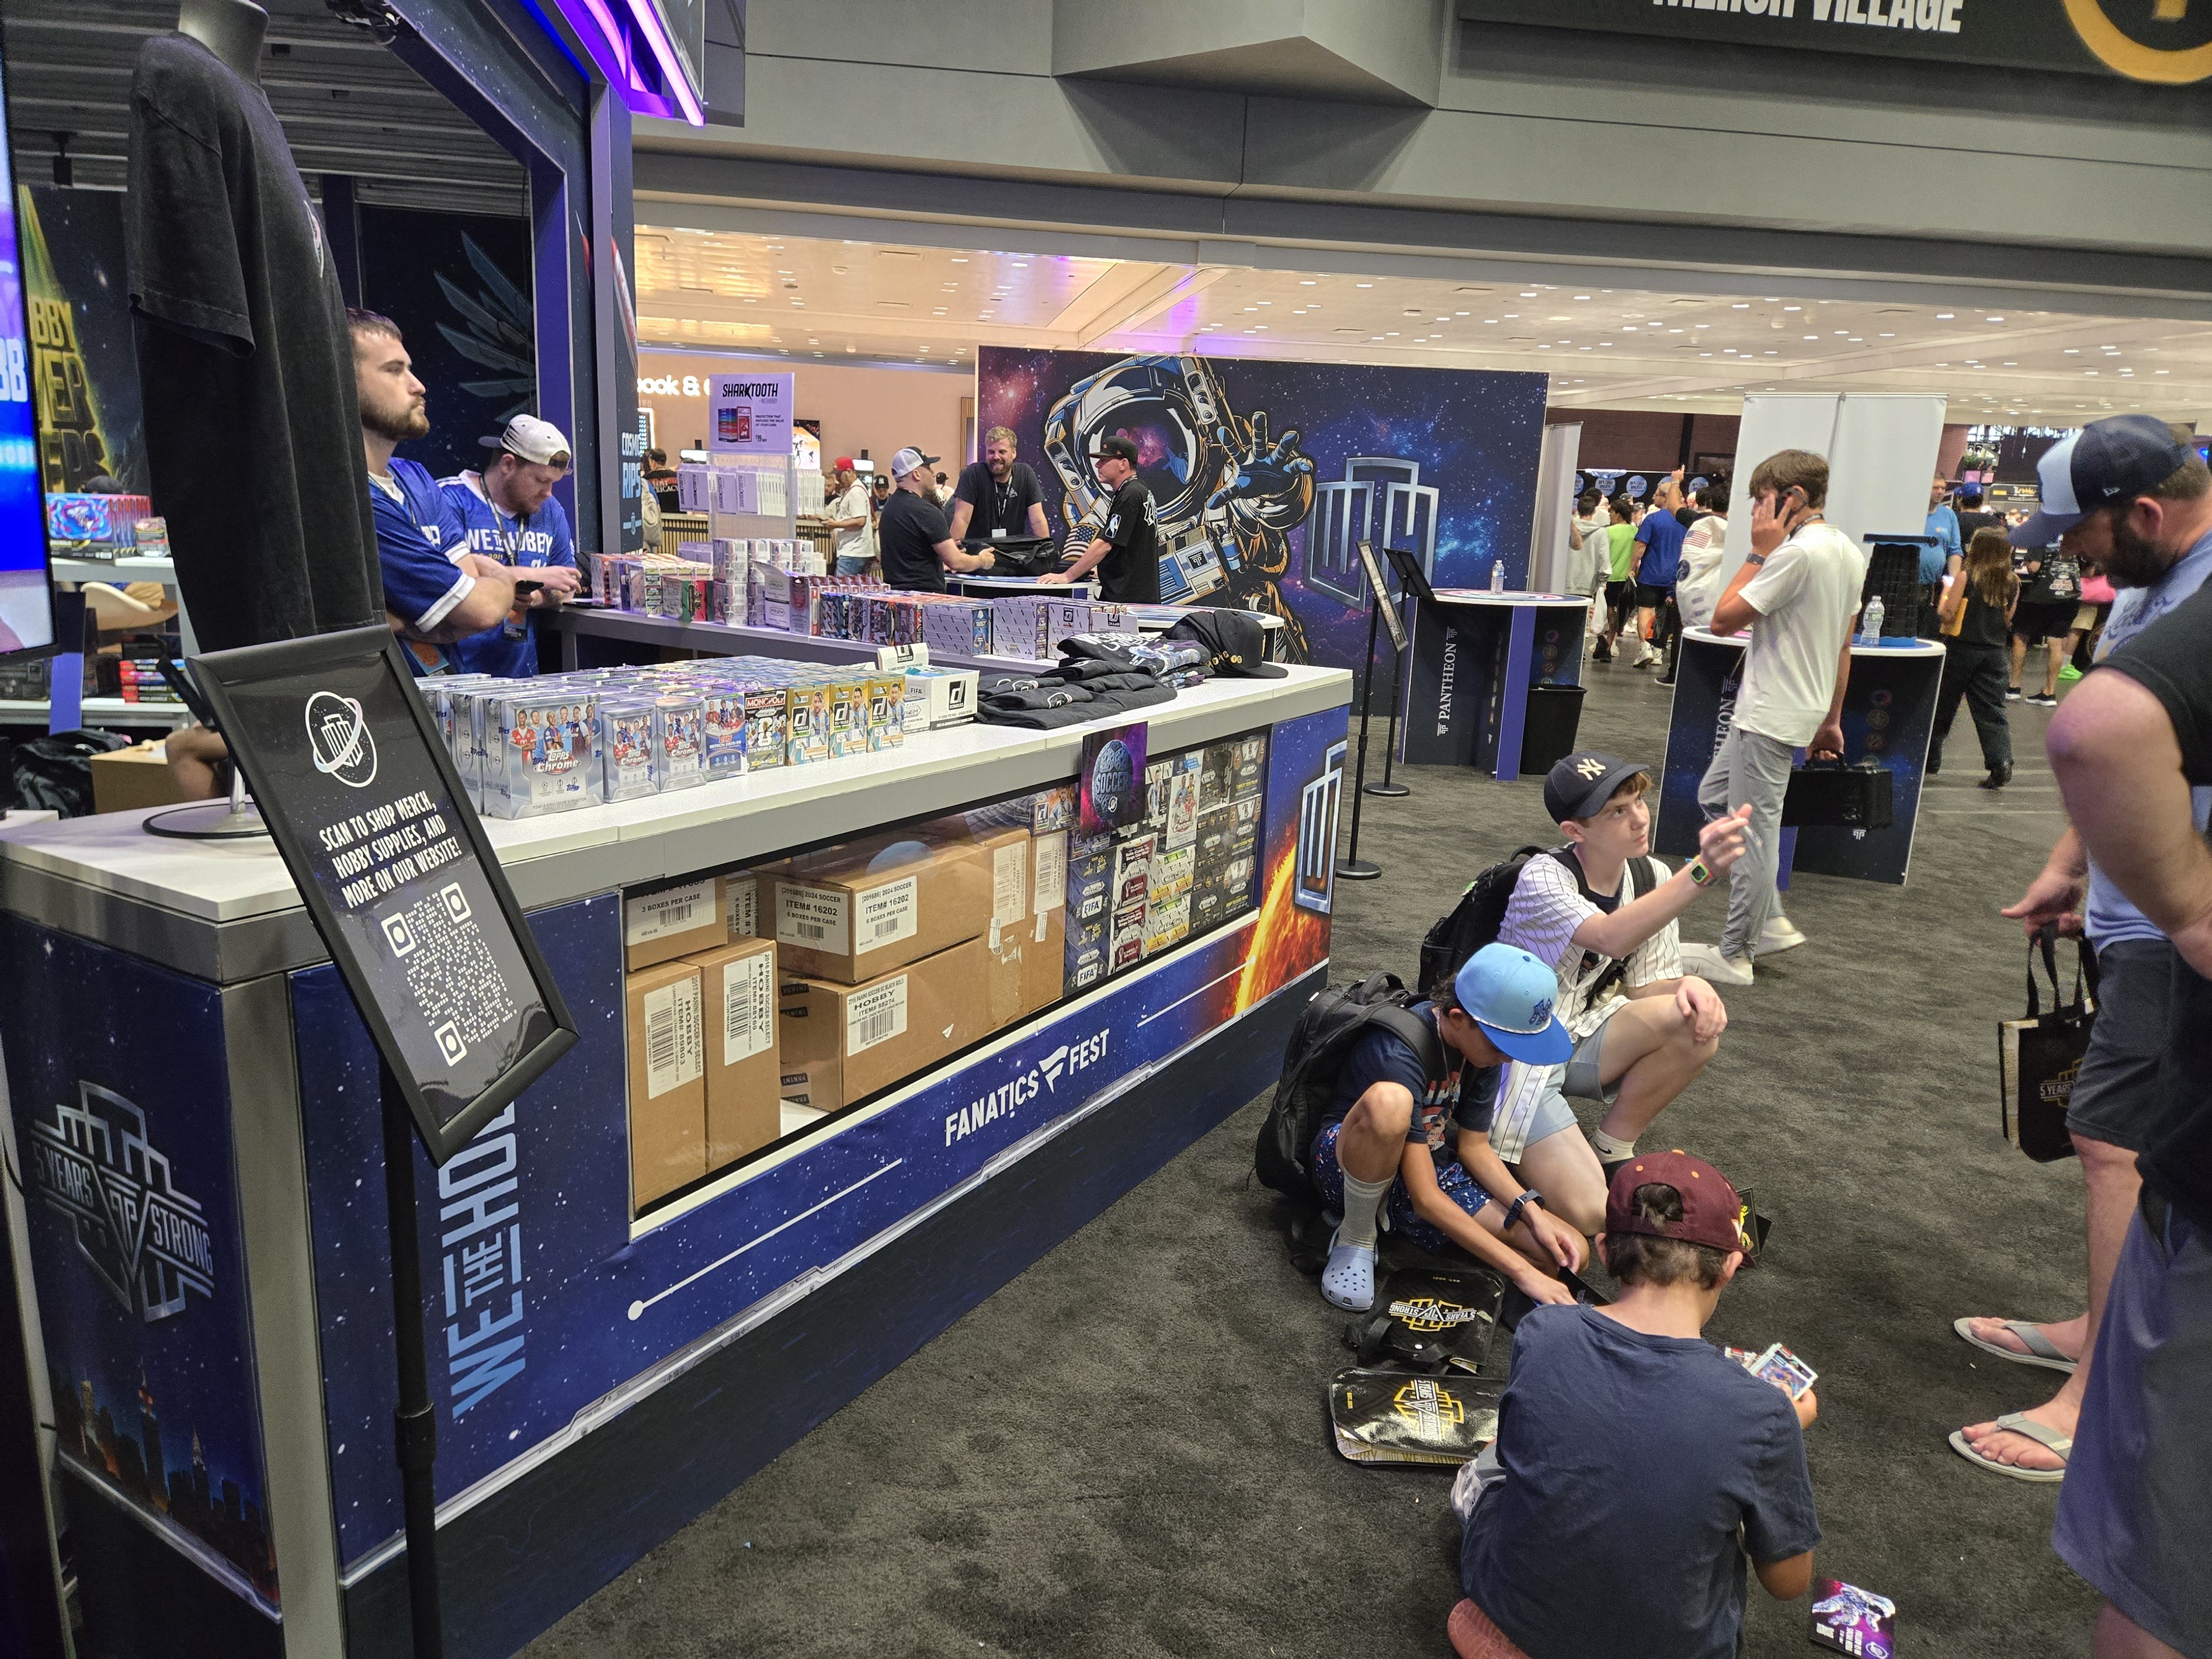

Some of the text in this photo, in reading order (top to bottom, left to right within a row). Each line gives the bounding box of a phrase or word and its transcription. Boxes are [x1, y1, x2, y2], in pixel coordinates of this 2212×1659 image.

[29, 295, 75, 353] BBY
[723, 382, 778, 400] SHARKTOOTH
[623, 462, 641, 499] RIPS
[1438, 642, 1457, 720] PANTHEON
[747, 697, 785, 707] MONOPOLY
[620, 757, 648, 766] Chrome
[671, 749, 697, 757] Chrome
[538, 759, 578, 772] Chrome
[1095, 771, 1128, 794] SOCCER
[320, 791, 437, 851] SCAN TO SHOP MERCH,
[332, 814, 446, 879] HOBBY SUPPLIES, AND
[341, 836, 462, 909] MORE ON OUR WEBSITE!
[894, 881, 911, 891] SOCCER
[648, 900, 669, 911] BOXES
[685, 893, 701, 902] CASE
[805, 891, 818, 899] 2024
[819, 894, 841, 904] SOCCER
[865, 894, 909, 915] ITEM# 16202
[1084, 901, 1099, 912] FIFA
[786, 900, 837, 916] ITEM# 16202
[870, 914, 886, 922] BOXES
[1079, 971, 1094, 982] FIFA
[857, 992, 867, 1001] PANINI
[868, 987, 880, 998] SOCCER
[885, 982, 895, 991] BLACK
[896, 978, 904, 987] GOLD
[854, 989, 895, 1011] HOBBY
[859, 998, 895, 1016] ITEM# 88274
[946, 1029, 1109, 1147] FANATICS FEST
[44, 1147, 95, 1208] YEARS
[150, 1203, 213, 1276] STRONG
[463, 1232, 503, 1307] THE
[1389, 1305, 1419, 1315] STRONG
[1446, 1312, 1469, 1321] YEARS
[447, 1290, 526, 1420] WE
